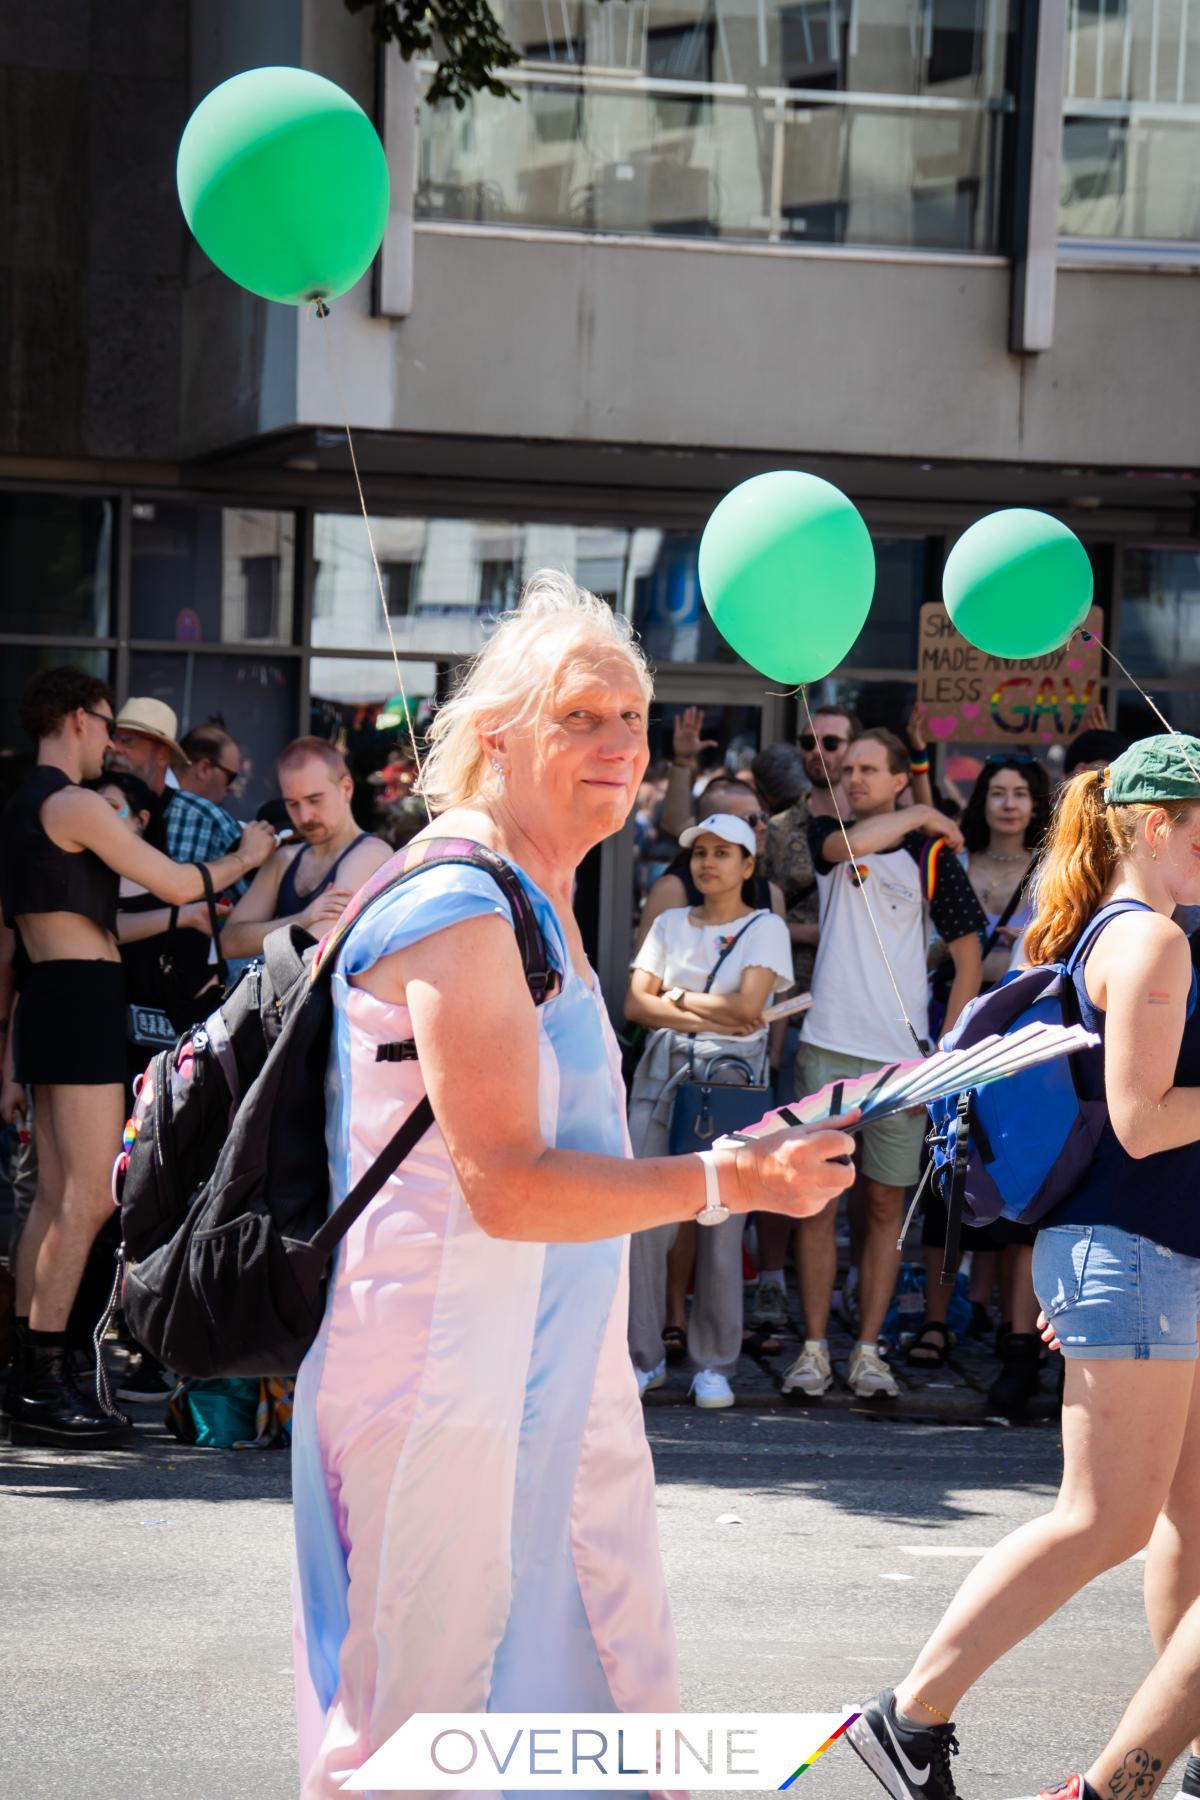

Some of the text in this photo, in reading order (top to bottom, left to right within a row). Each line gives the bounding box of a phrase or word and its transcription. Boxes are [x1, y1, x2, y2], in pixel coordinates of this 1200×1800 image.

[922, 647, 978, 671] MADE
[920, 677, 1096, 734] LESS GAY
